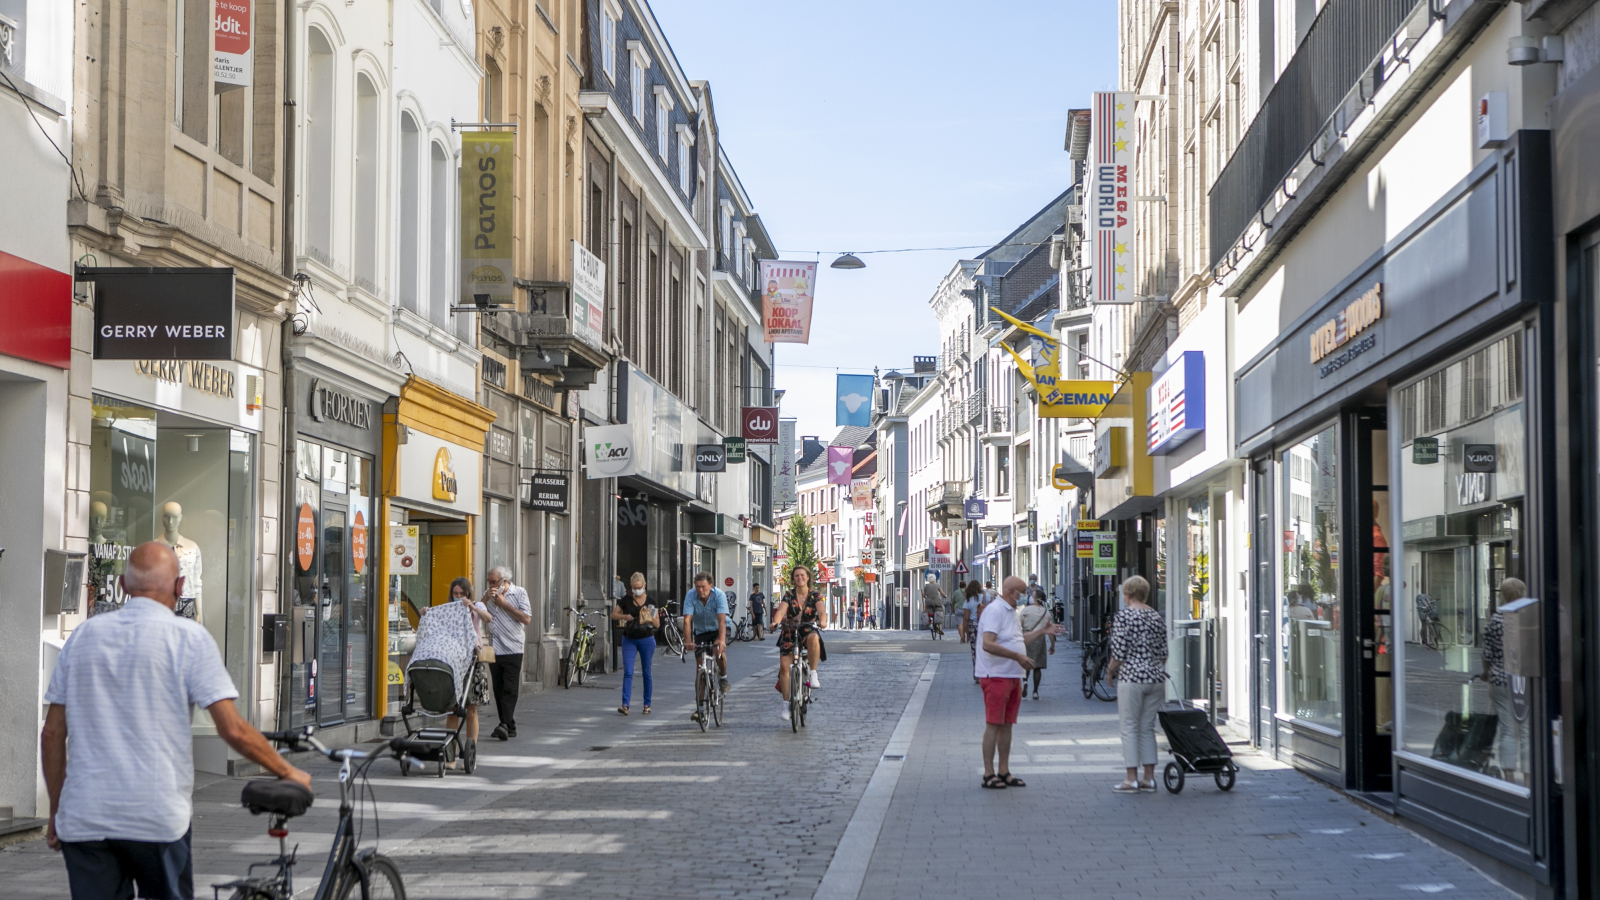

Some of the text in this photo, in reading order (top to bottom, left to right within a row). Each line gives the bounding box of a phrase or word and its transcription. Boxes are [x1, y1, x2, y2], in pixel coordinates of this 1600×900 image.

[220, 1, 227, 9] te
[229, 2, 247, 14] koop
[215, 13, 247, 35] ddit.be
[1098, 166, 1115, 228] WORLD
[1117, 165, 1128, 228] MEGA
[474, 156, 496, 250] Panos
[471, 274, 502, 282] Panos
[772, 307, 798, 318] KOOP
[767, 317, 803, 329] LOKAAL
[100, 325, 226, 338] GERRY WEBER
[135, 360, 235, 398] GERRY WEBER
[1043, 393, 1110, 405] EMAN
[324, 388, 372, 430] FORMEN
[607, 447, 628, 457] ACV
[696, 454, 723, 462] ONLY
[534, 477, 565, 486] BRASSERIE
[782, 477, 789, 486] De
[538, 492, 559, 500] RERUM
[532, 500, 564, 508] NOVARUM
[864, 512, 874, 548] EMA
[94, 543, 137, 560] VANAF 2 ST
[1100, 544, 1111, 552] DG
[100, 574, 131, 603] -50
